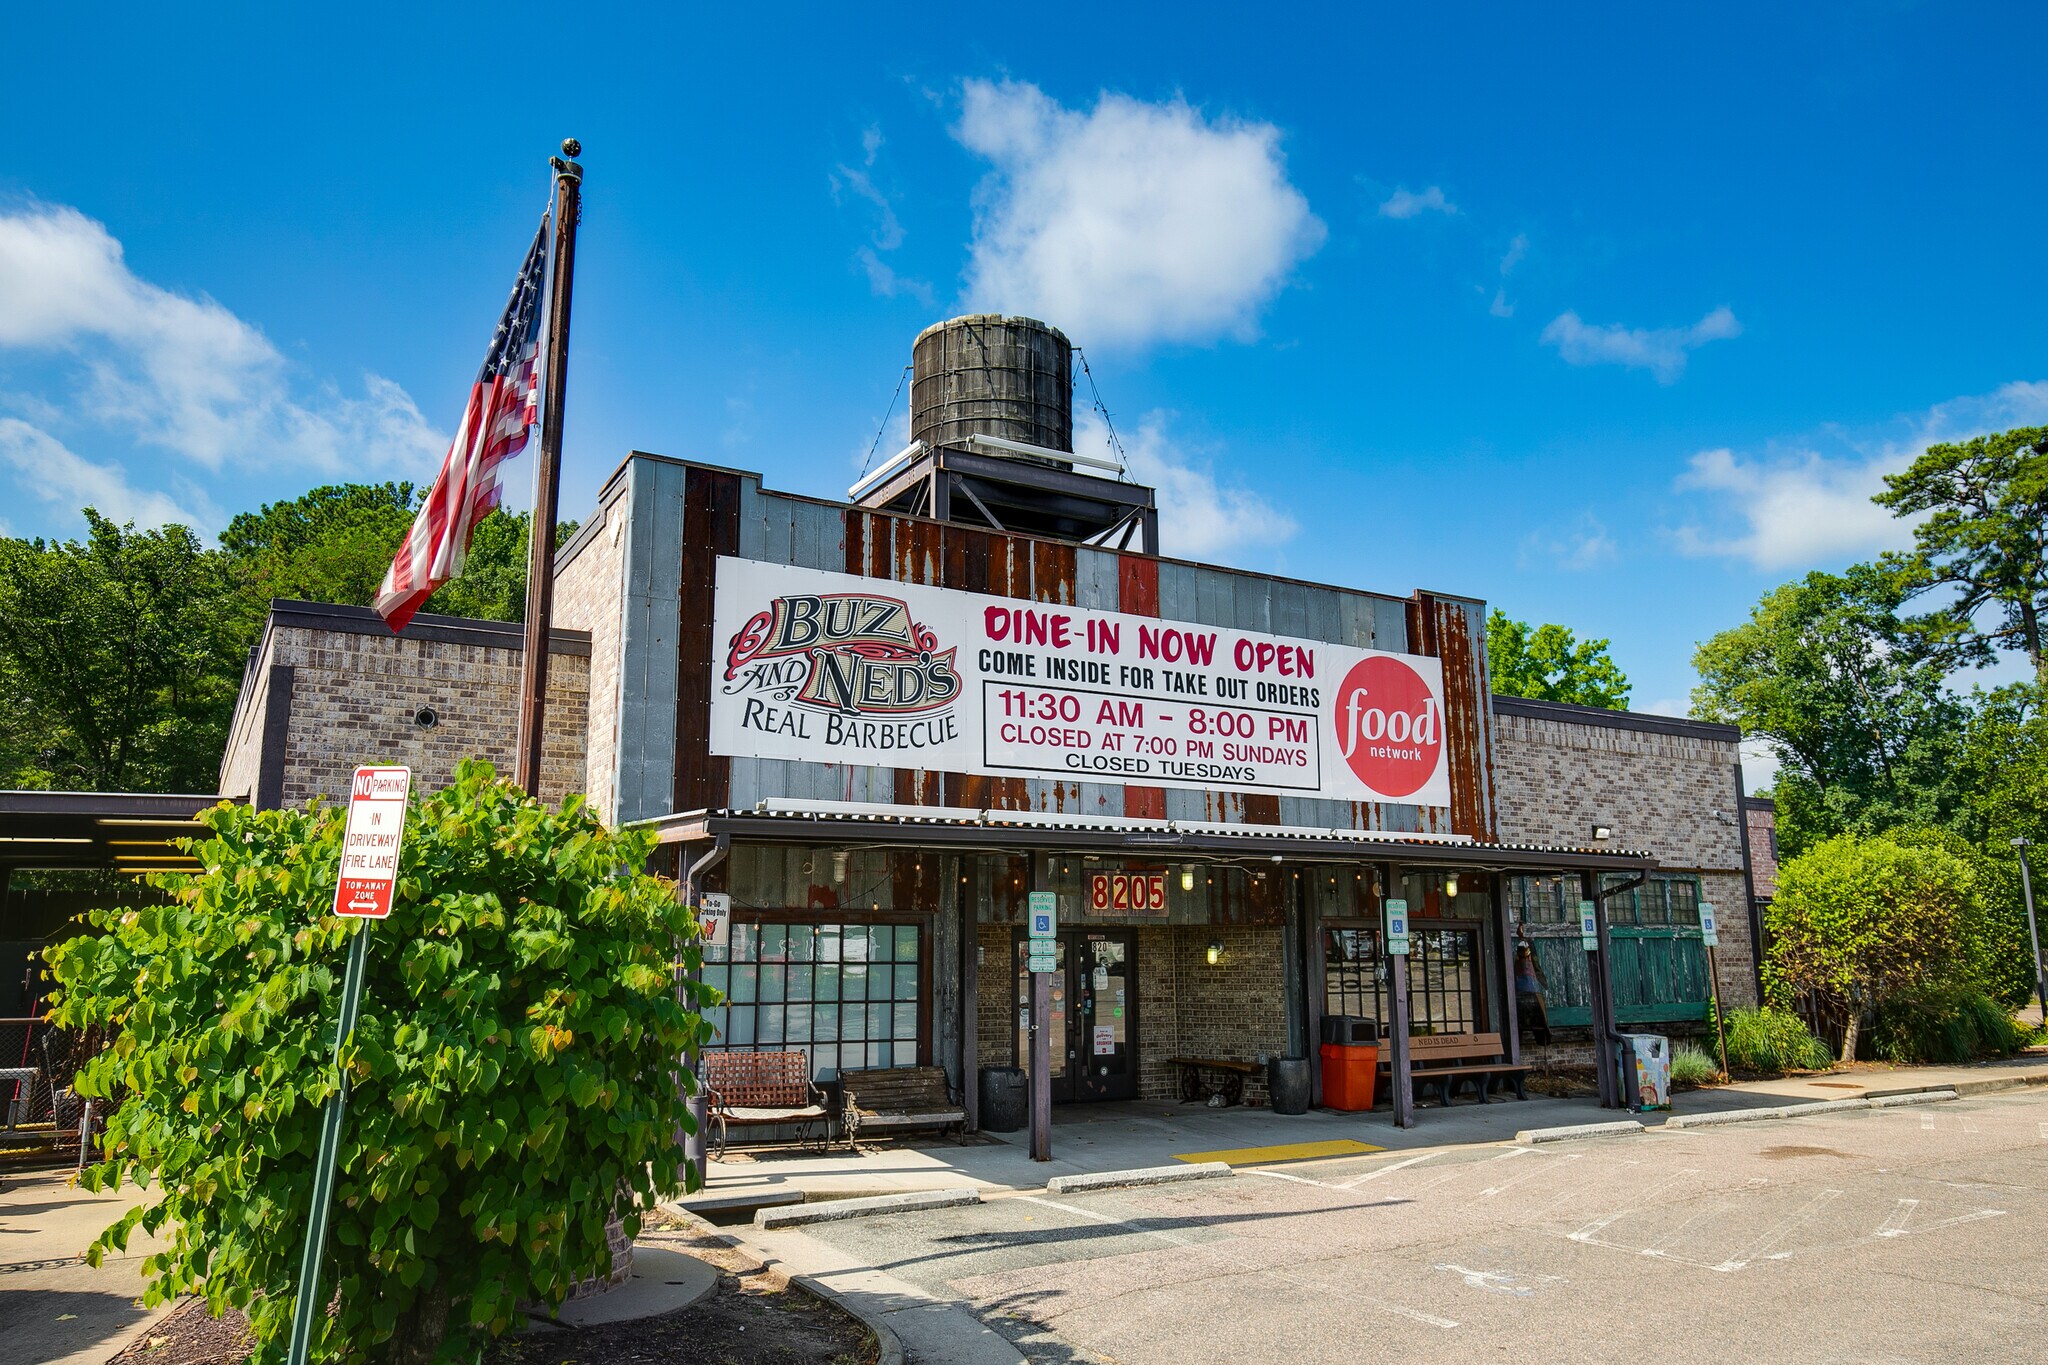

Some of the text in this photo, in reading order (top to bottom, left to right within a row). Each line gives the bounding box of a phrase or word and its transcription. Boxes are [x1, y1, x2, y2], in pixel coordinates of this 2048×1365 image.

[772, 594, 910, 650] BUZ
[983, 605, 1315, 680] DINE-IN NOW OPEN
[721, 657, 807, 697] AND
[811, 648, 958, 715] NED'S
[978, 648, 1321, 708] COME INSIDE FOR TAKE OUT ORDERS
[741, 697, 959, 750] REAL BARBECUE
[998, 689, 1081, 723] 11:30
[1095, 699, 1144, 729] AM
[1188, 708, 1256, 739] 8:00
[1268, 717, 1308, 744] PM
[1344, 687, 1437, 759] food
[1000, 723, 1307, 767] CLOSED AT 7:00 PM SUNDAYS
[1370, 746, 1422, 761] network
[354, 775, 405, 796] NO PARKING
[1065, 753, 1256, 781] CLOSED TUESDAYS
[371, 812, 381, 826] IN
[350, 833, 396, 847] DRIVEWAY
[345, 854, 394, 869] FIRE LANE
[345, 880, 387, 891] TOW-AWAY
[354, 891, 375, 900] ZONE
[1092, 875, 1164, 910] 8205
